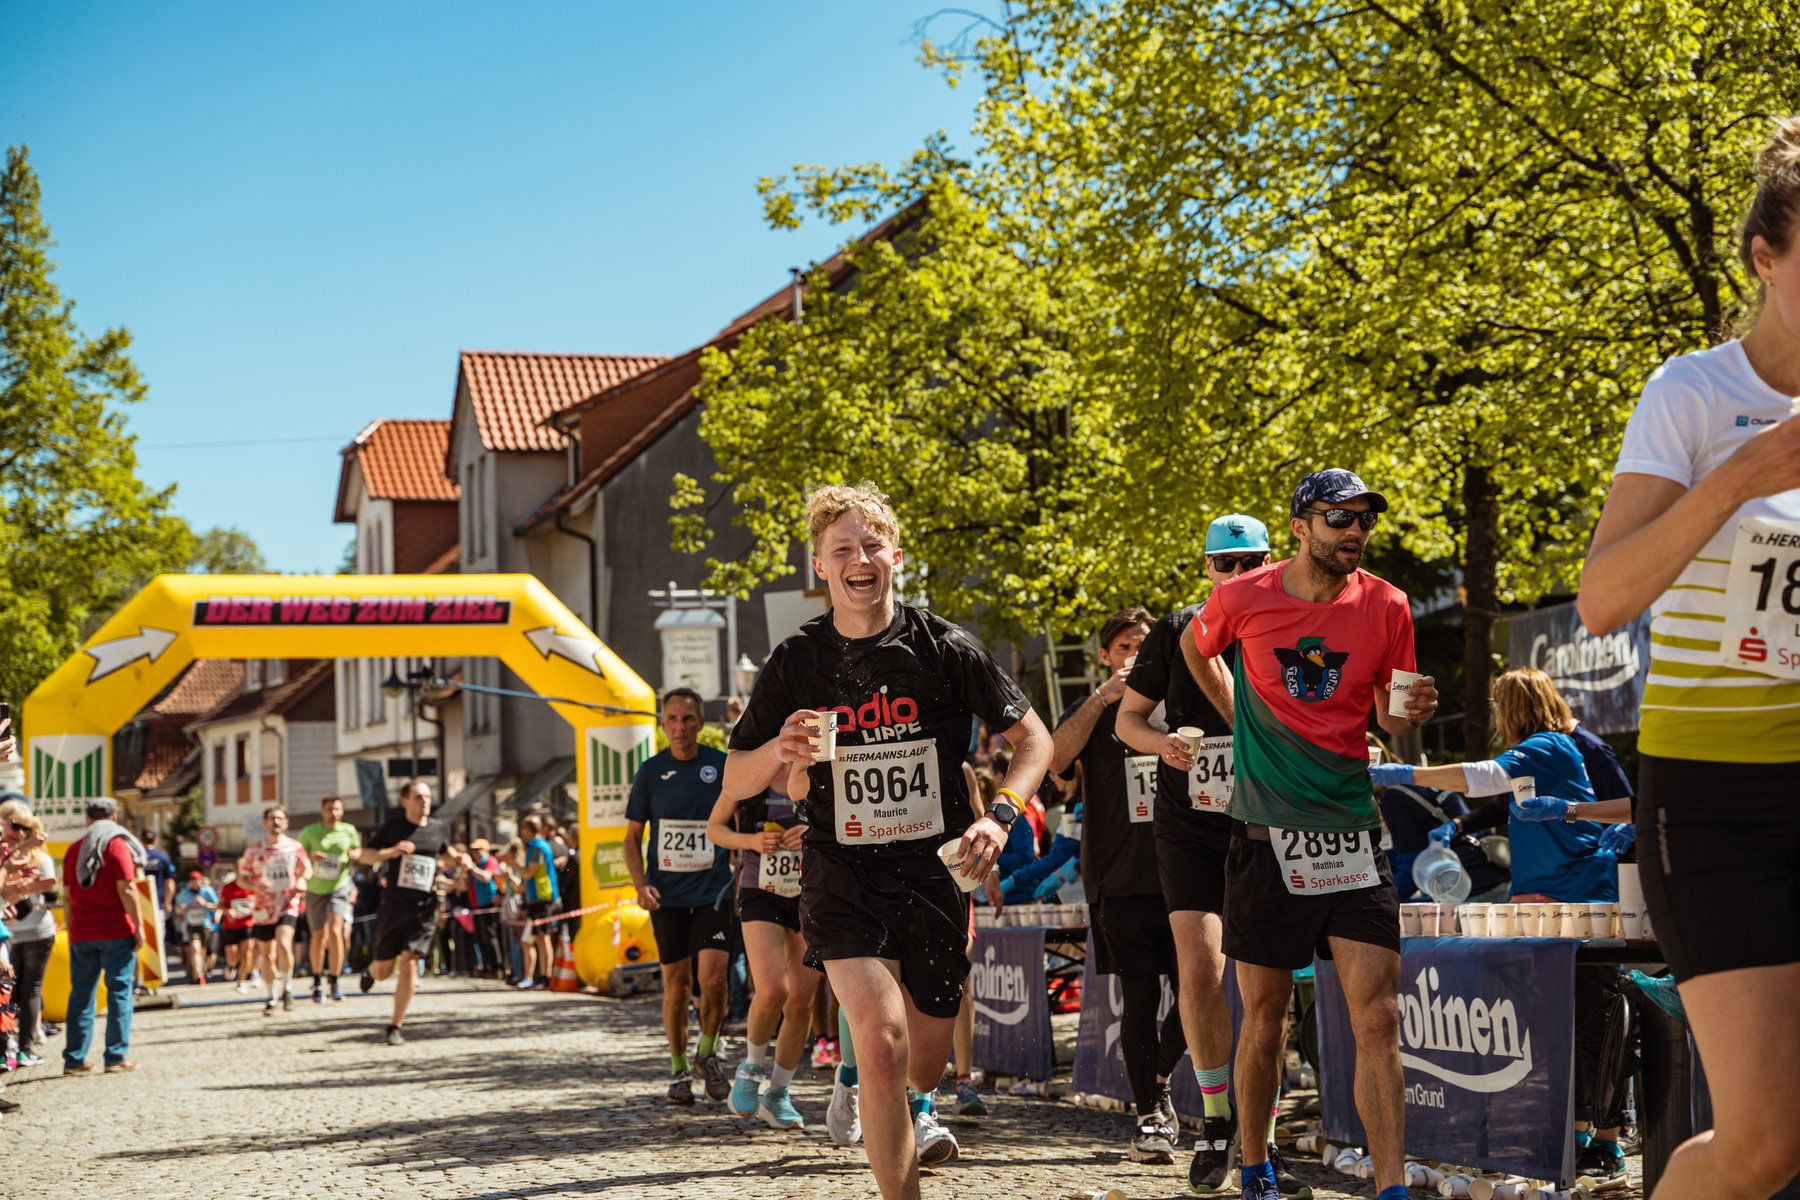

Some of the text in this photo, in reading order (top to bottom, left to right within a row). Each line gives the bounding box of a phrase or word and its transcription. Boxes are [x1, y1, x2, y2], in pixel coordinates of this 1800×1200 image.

[204, 595, 504, 623] DER WEG ZUM ZIEL
[1530, 625, 1631, 677] Carolinen
[1286, 666, 1299, 697] TEAM
[815, 685, 918, 732] adio
[861, 721, 922, 744] LIPPE
[846, 746, 929, 762] HERMANNSLAUF
[844, 762, 930, 805] 6964
[873, 807, 908, 818] Maurice
[1215, 798, 1230, 809] Sp
[869, 819, 933, 839] Sparkasse
[664, 832, 706, 851] 2241
[1281, 829, 1362, 861] 2899
[1312, 860, 1345, 871] Matthias
[1310, 872, 1369, 890] Sparkasse
[1415, 1083, 1445, 1109] Grund
